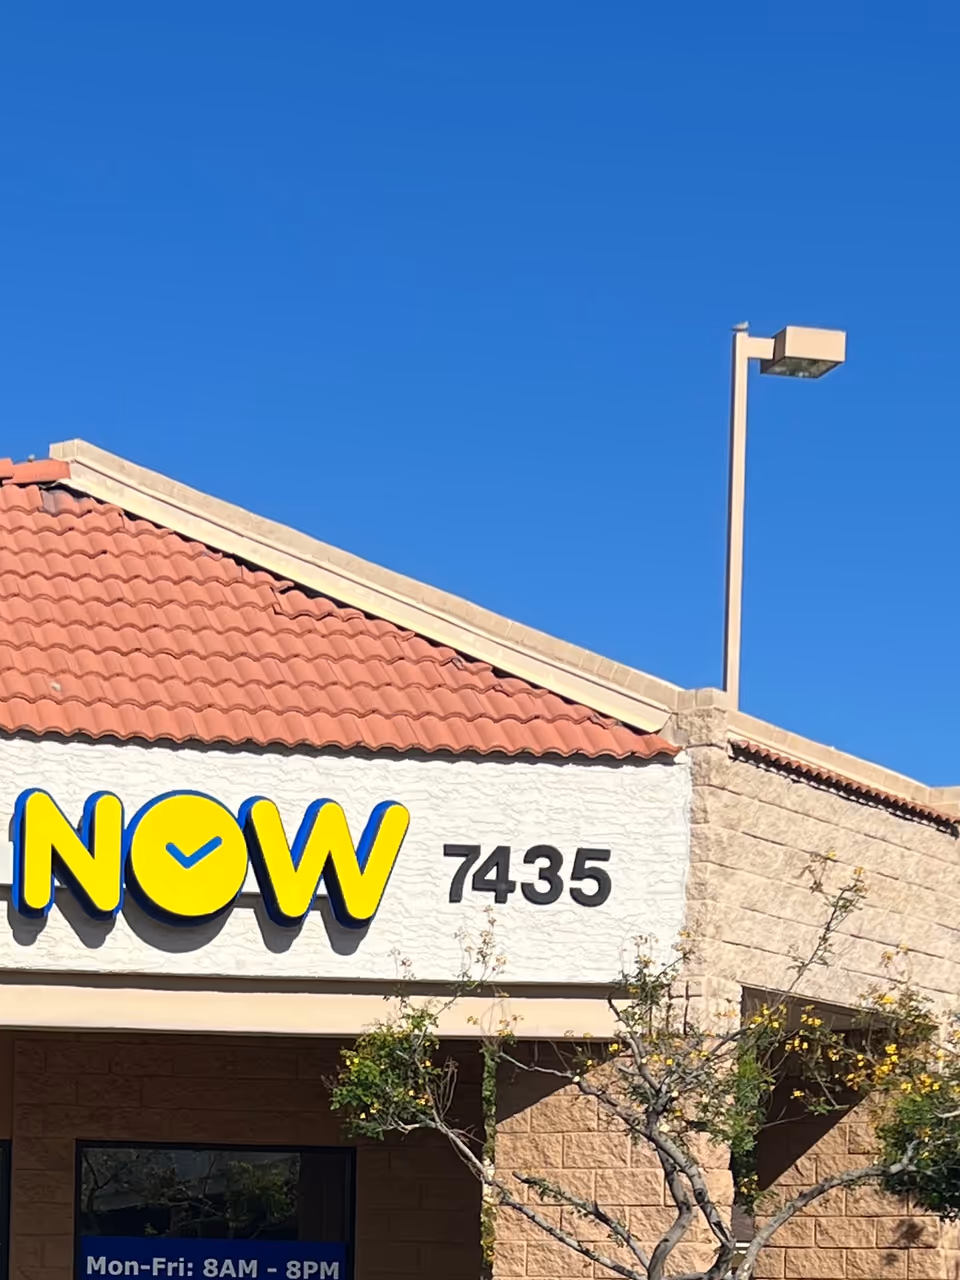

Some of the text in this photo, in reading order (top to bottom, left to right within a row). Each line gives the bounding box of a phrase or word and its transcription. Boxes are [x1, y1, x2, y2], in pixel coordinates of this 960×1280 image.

[12, 787, 410, 930] NOW
[444, 844, 613, 908] 7435
[86, 1256, 194, 1277] Mon-Fri:
[203, 1258, 258, 1279] 8AM
[286, 1260, 340, 1280] 8PM
